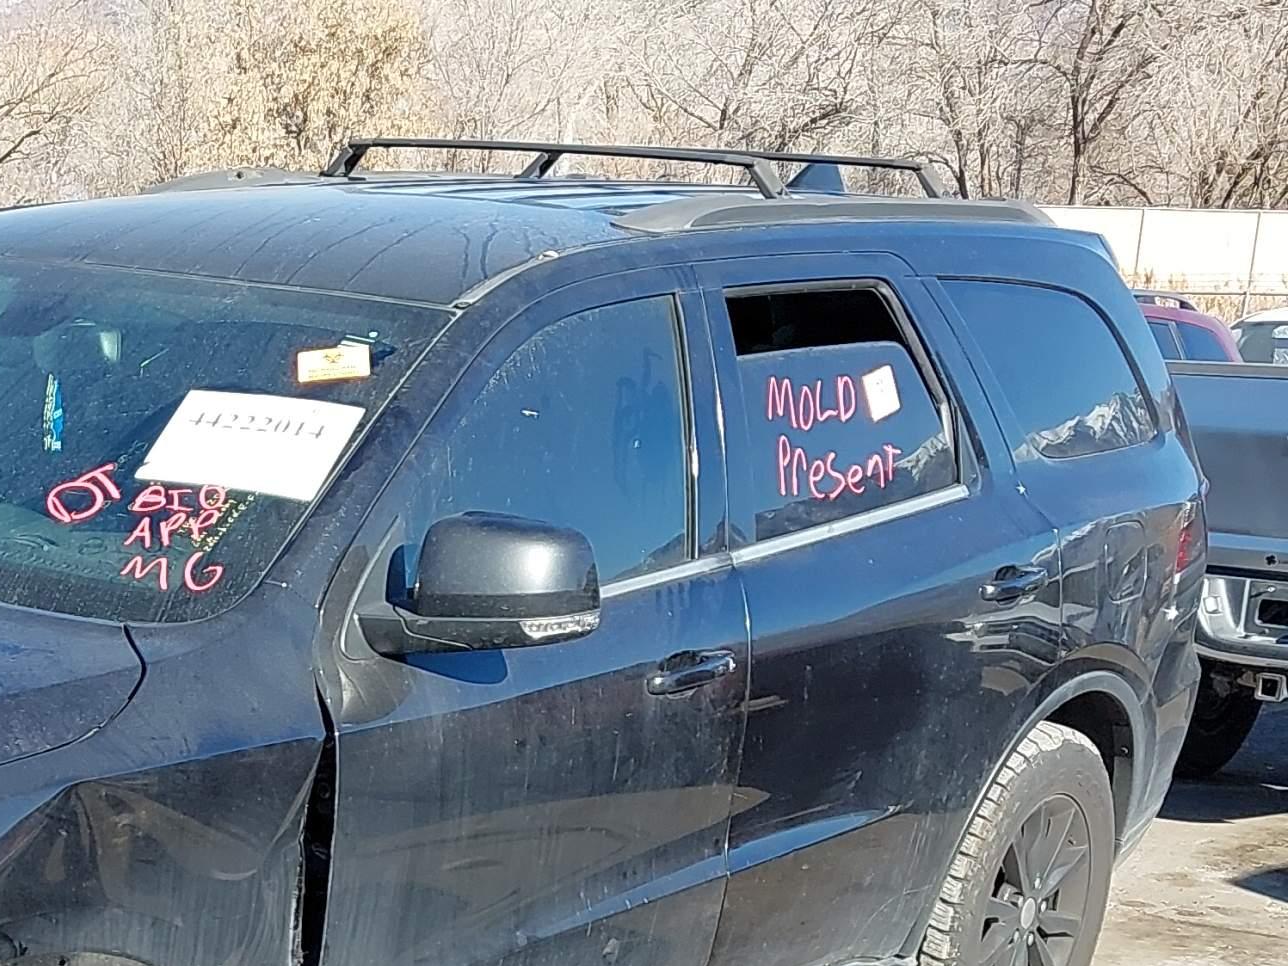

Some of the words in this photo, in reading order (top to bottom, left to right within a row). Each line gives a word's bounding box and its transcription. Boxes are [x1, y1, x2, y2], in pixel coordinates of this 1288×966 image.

[768, 375, 856, 431] MOLD
[778, 434, 902, 499] Present
[129, 484, 230, 512] BIO
